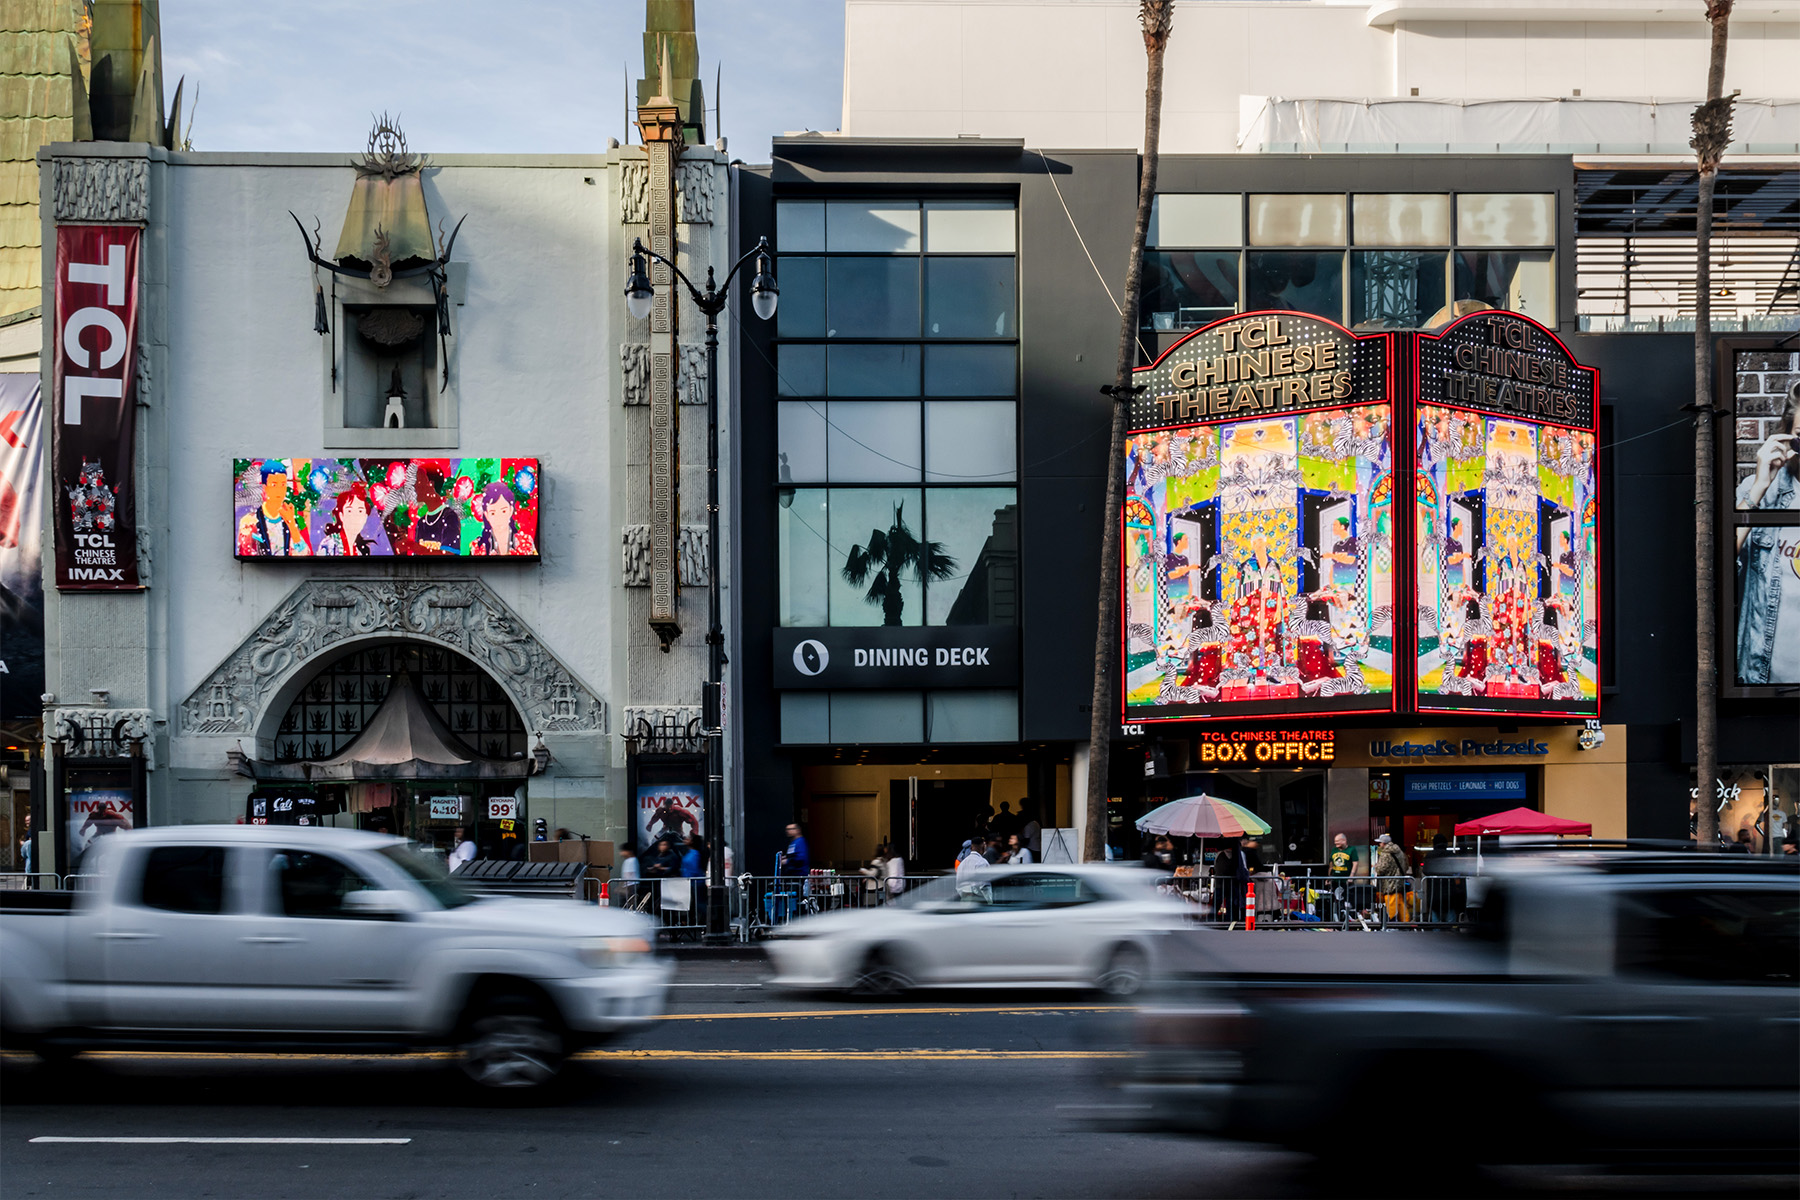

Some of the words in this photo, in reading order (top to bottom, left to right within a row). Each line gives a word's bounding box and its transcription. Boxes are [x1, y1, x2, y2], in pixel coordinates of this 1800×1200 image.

[63, 244, 127, 425] TCL
[1217, 319, 1288, 351] TCL
[1487, 317, 1537, 352] TCL
[1171, 342, 1337, 387] CHINESE
[1455, 343, 1567, 388] CHINESE
[1156, 372, 1352, 420] THEATRES
[1444, 371, 1578, 419] THEATRES
[73, 534, 116, 548] TCL
[74, 549, 116, 557] CHINESE
[75, 557, 117, 565] THEATRES
[68, 568, 125, 581] IMAX
[854, 648, 929, 667] DINING
[935, 647, 990, 666] DECK
[1121, 725, 1145, 735] TCL
[1585, 719, 1602, 729] TCL
[1201, 732, 1229, 742] TCL
[1230, 731, 1277, 741] CHINESE
[1279, 730, 1335, 741] THEATRES
[1201, 742, 1248, 761] BOX
[1255, 742, 1335, 761] OFFICE
[1369, 739, 1457, 757] Wetzel's
[1460, 738, 1549, 756] Pretzels
[1411, 782, 1428, 791] FRESH
[1428, 781, 1452, 790] PRETZELS
[1459, 781, 1487, 790] LEMONADE
[1494, 781, 1505, 789] HOT
[1505, 781, 1520, 789] DOGS
[74, 800, 133, 813] IMAX
[641, 796, 701, 808] IMAX
